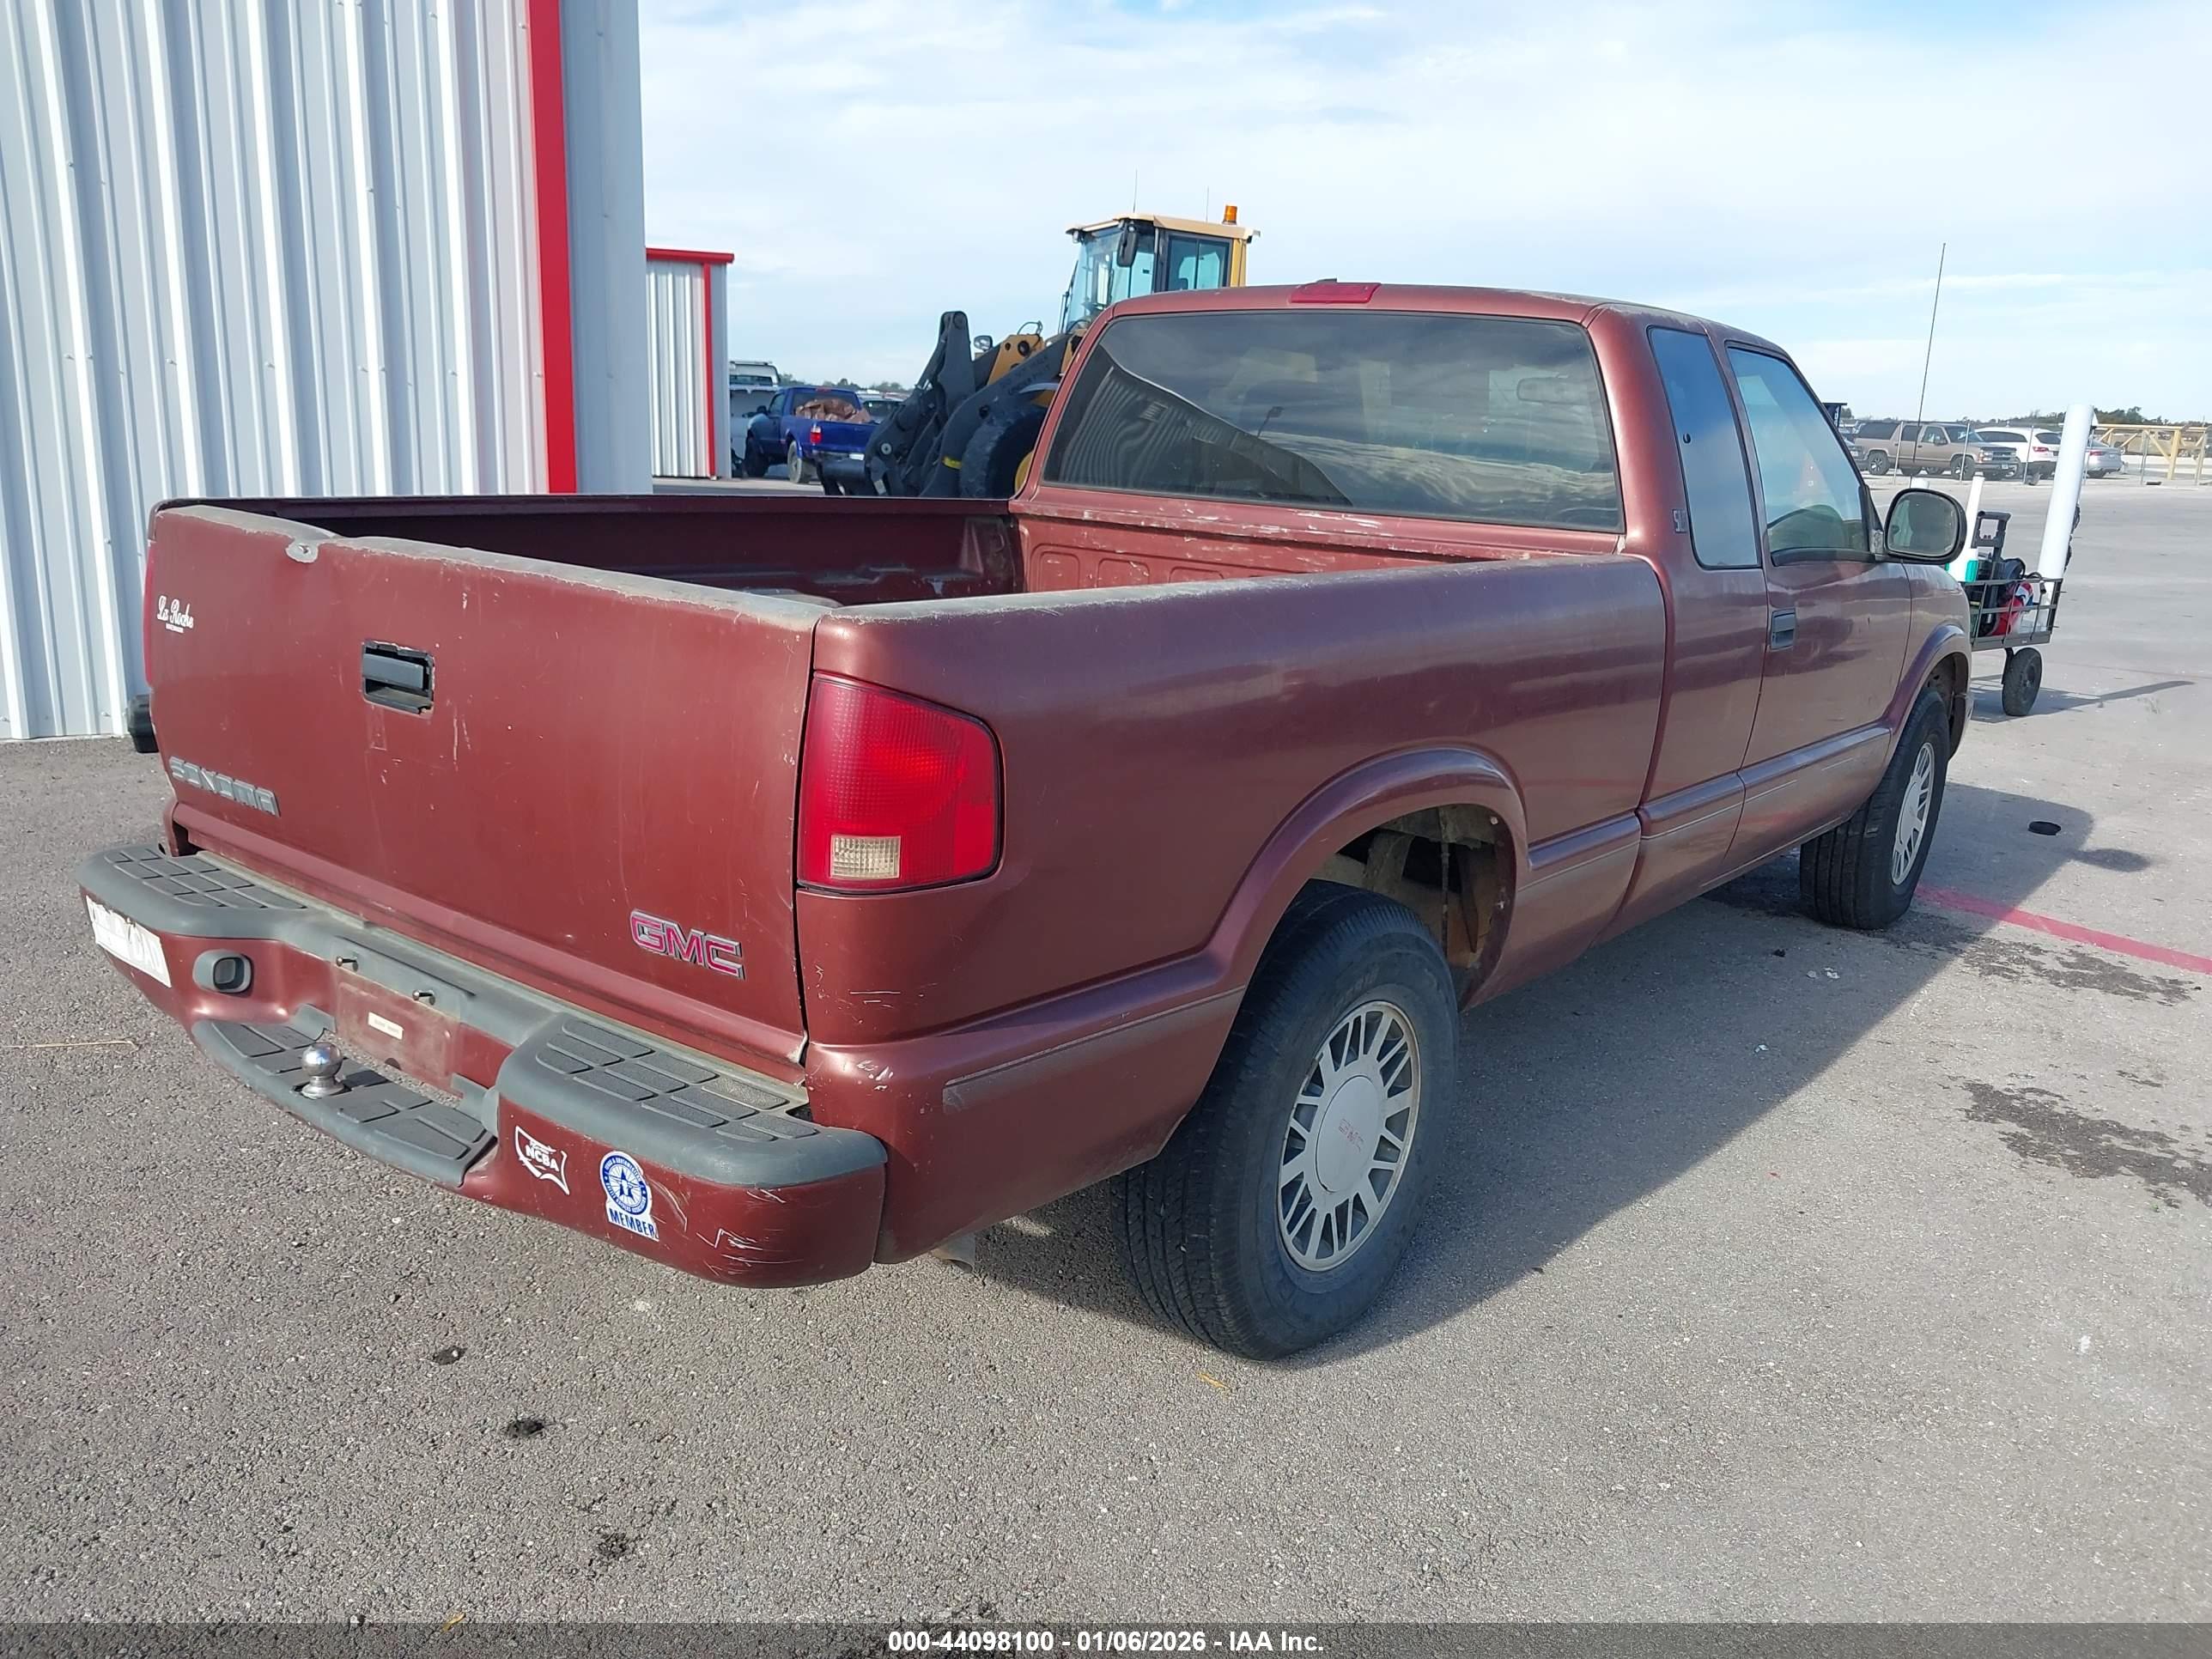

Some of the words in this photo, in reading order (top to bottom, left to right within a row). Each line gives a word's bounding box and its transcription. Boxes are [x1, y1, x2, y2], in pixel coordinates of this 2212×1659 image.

[169, 756, 280, 817] SONOMA
[629, 908, 745, 980] GMC
[609, 1207, 658, 1238] MEMBER
